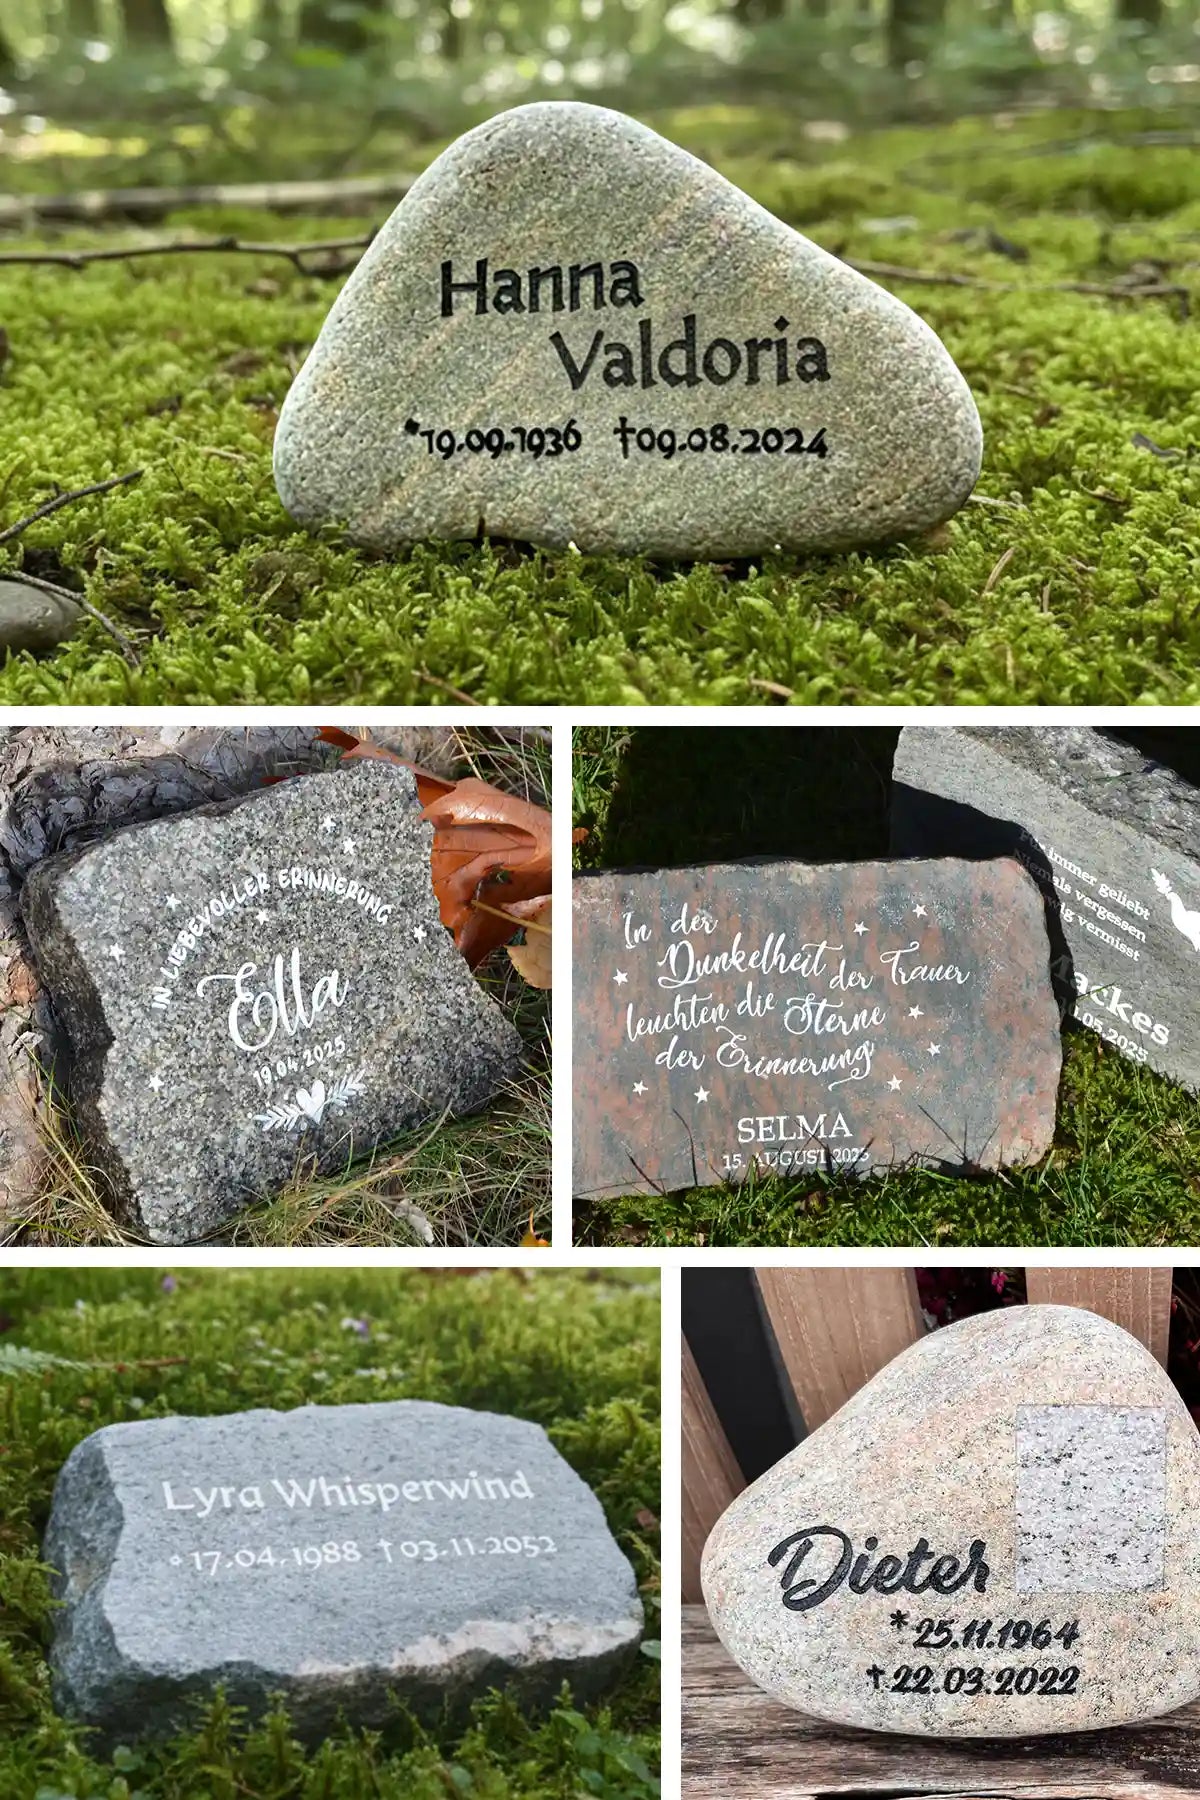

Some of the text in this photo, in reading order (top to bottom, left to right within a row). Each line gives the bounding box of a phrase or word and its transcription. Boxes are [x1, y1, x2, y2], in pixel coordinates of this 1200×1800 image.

[440, 257, 645, 317] Hanna
[549, 313, 831, 391] Valdoria
[1047, 844, 1097, 886] immer
[1099, 880, 1151, 922] geliebt
[152, 868, 393, 1010] IN LIEBEVOLLER ERINNERUNG
[623, 902, 718, 950] In der
[1075, 889, 1147, 944] vergessen
[1077, 915, 1141, 962] vermisst
[657, 932, 970, 992] Dunkelheit der Trauer
[196, 950, 350, 1052] Ella
[627, 981, 886, 1042] leuchten die Sterne
[253, 1034, 347, 1087] 19.04.2025
[655, 1026, 875, 1092] der Erinnerung
[737, 1113, 853, 1144] SELMA
[722, 1153, 746, 1170] 15.
[161, 1469, 535, 1518] Lyra Whisperwind
[767, 1525, 990, 1611] Dieter
